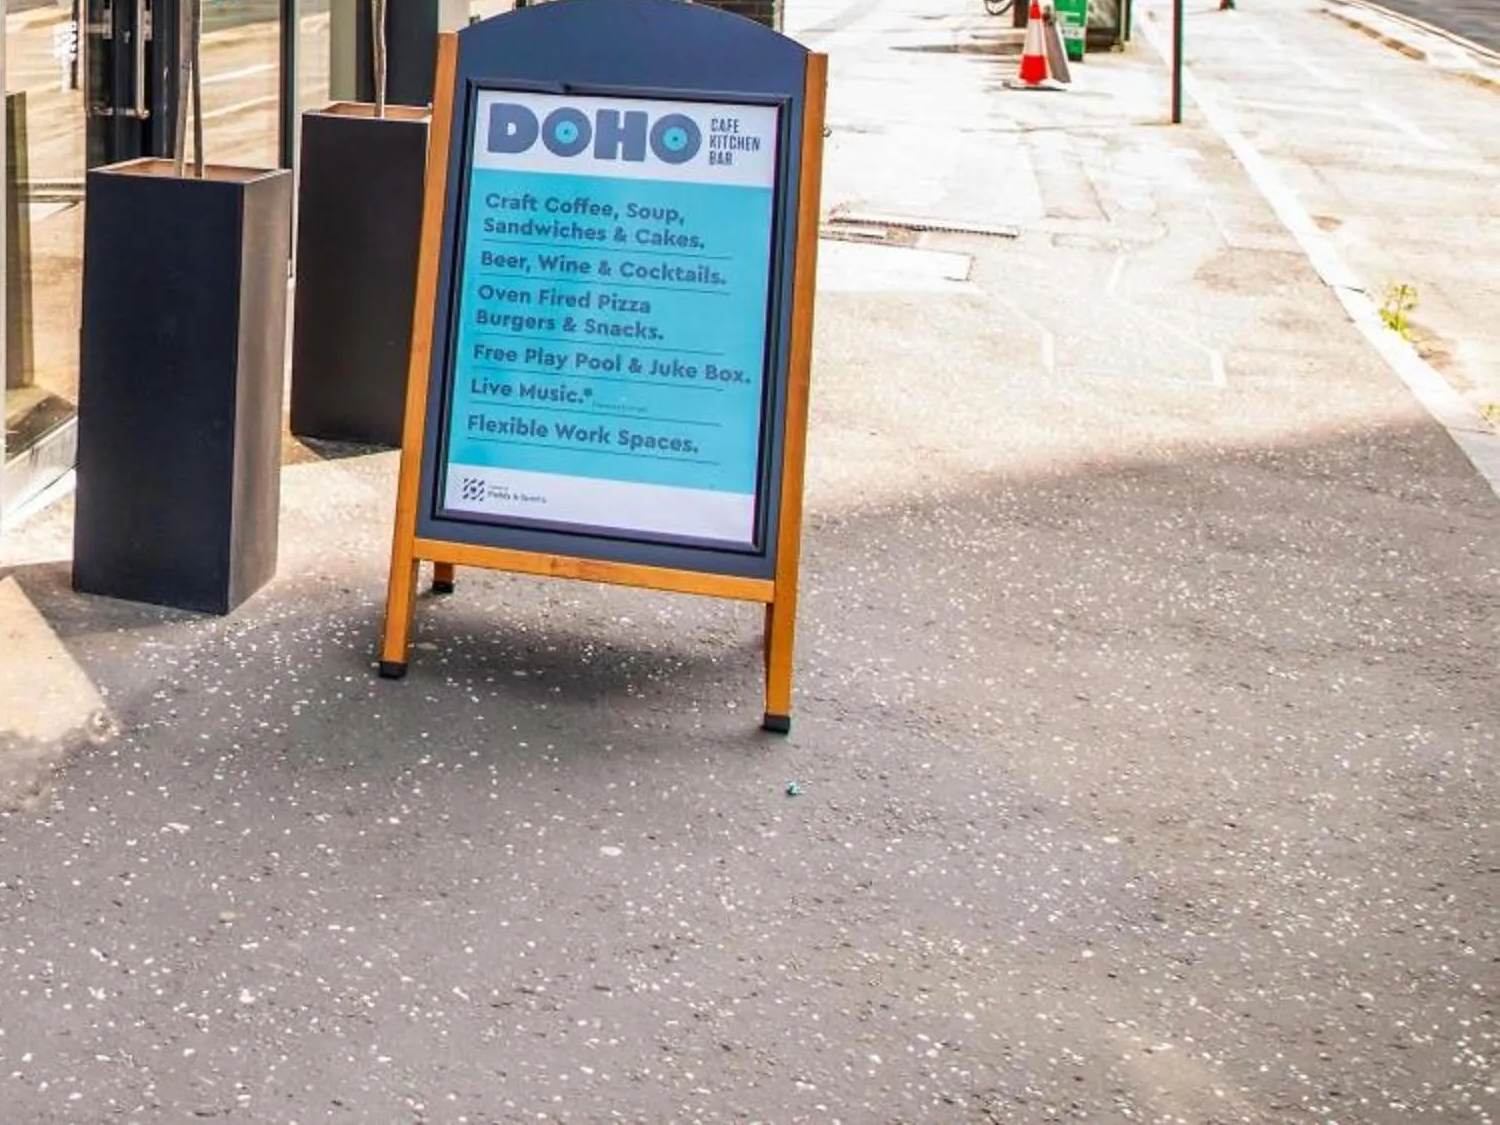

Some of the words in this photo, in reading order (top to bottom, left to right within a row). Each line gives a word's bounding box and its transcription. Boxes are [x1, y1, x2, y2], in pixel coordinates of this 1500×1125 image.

[487, 101, 703, 165] DOHO
[710, 118, 740, 134] CAFE
[708, 135, 761, 152] KITCHEN
[708, 150, 734, 166] BAR
[485, 192, 537, 213] Craft
[545, 196, 619, 221] Coffee,
[627, 202, 685, 226] Soup,
[483, 216, 607, 243] Sandwiches
[613, 223, 628, 242] &
[635, 227, 705, 250] Cakes.
[480, 250, 531, 273] Beer,
[537, 252, 591, 275] Wine
[597, 257, 612, 275] &
[619, 260, 727, 286] Cocktails.
[478, 284, 531, 304] Oven
[538, 287, 591, 309] Fired
[598, 292, 651, 314] Pizza
[475, 308, 556, 334] Burgers
[562, 315, 577, 333] &
[584, 318, 665, 341] Snacks.
[473, 343, 518, 363] Free
[524, 345, 568, 370] Play
[575, 350, 622, 373] Pool
[627, 357, 643, 374] &
[648, 358, 698, 380] Juke
[704, 363, 751, 384] Box.
[471, 377, 512, 398] Live
[467, 414, 548, 438] Flexible
[555, 421, 611, 445] Work
[617, 428, 700, 454] Spaces.
